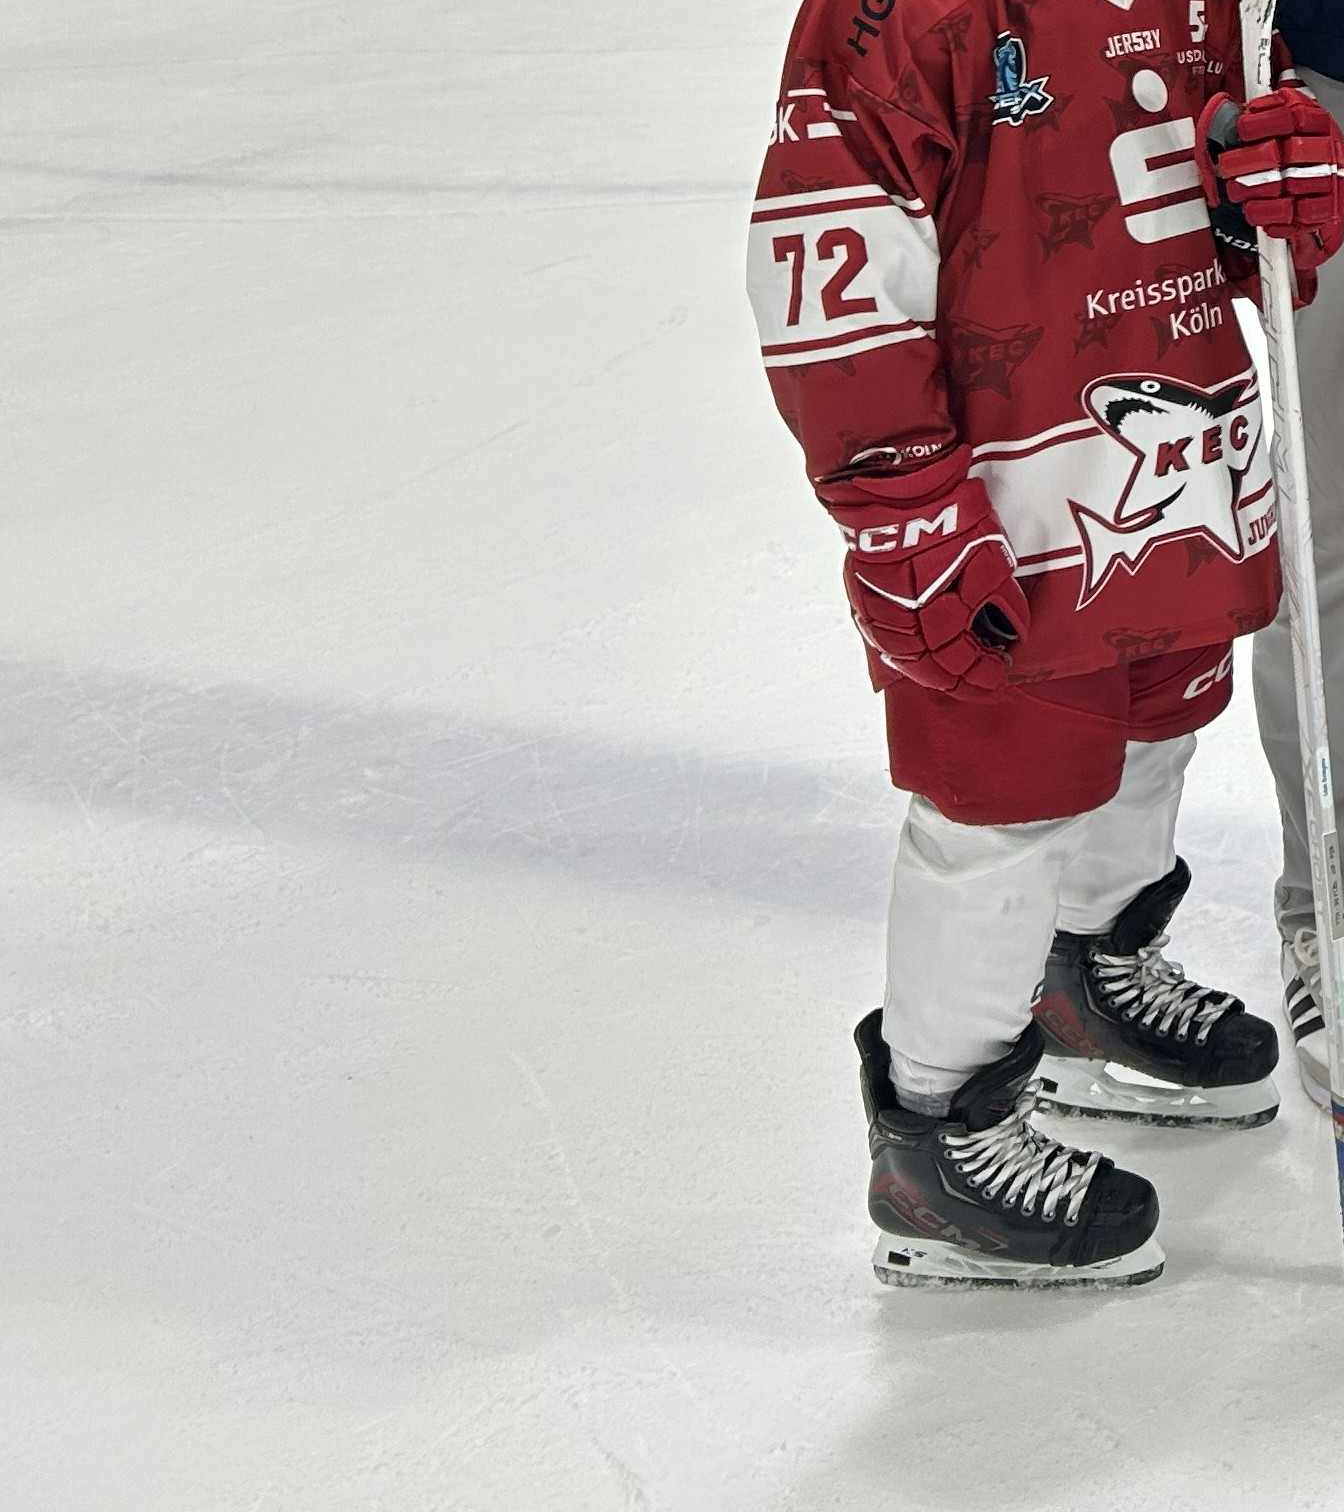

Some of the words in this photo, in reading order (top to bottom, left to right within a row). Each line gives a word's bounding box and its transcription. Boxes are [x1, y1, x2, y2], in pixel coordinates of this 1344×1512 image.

[772, 227, 878, 327] 72
[1086, 258, 1228, 319] Kreisspark
[1169, 302, 1223, 340] Köln
[1154, 415, 1249, 478] KEC
